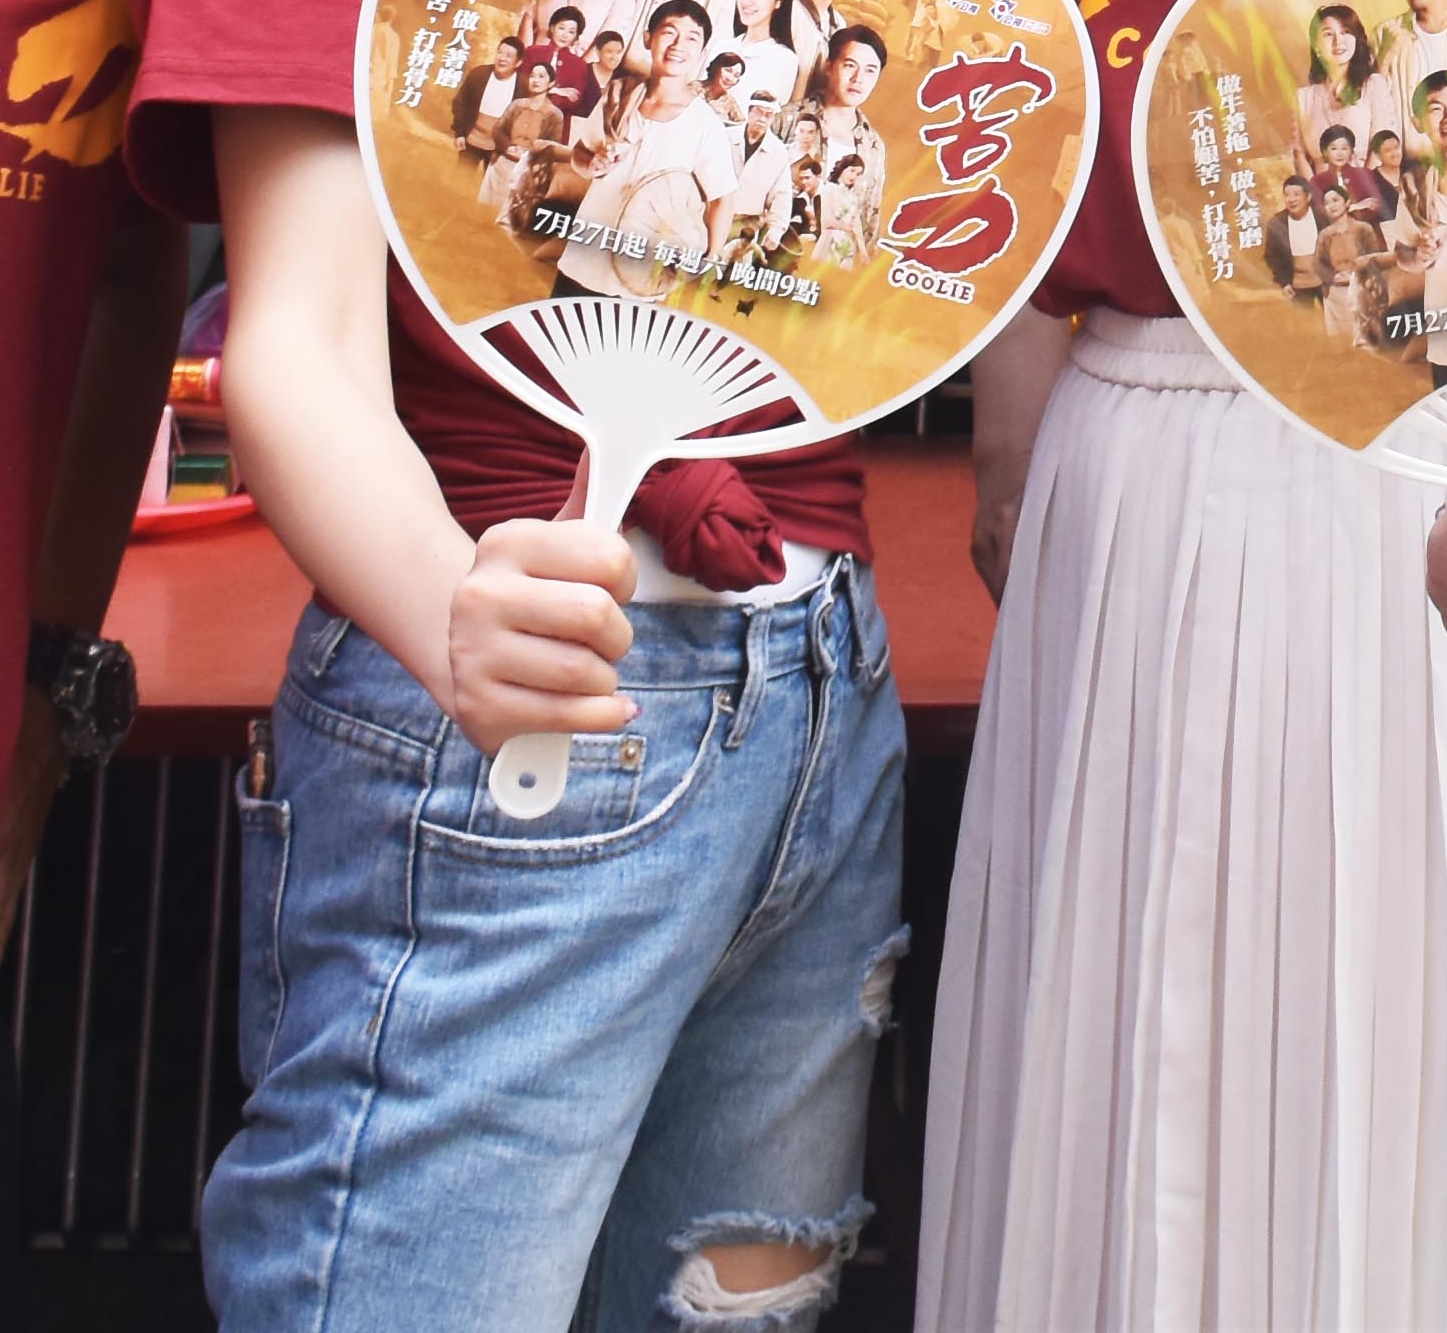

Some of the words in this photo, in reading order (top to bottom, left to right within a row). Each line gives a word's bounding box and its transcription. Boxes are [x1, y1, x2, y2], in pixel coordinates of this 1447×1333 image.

[533, 206, 649, 261] 7月27日起
[654, 239, 727, 281] 每週六
[730, 263, 821, 306] 晚間9點
[891, 268, 973, 301] COOLIE
